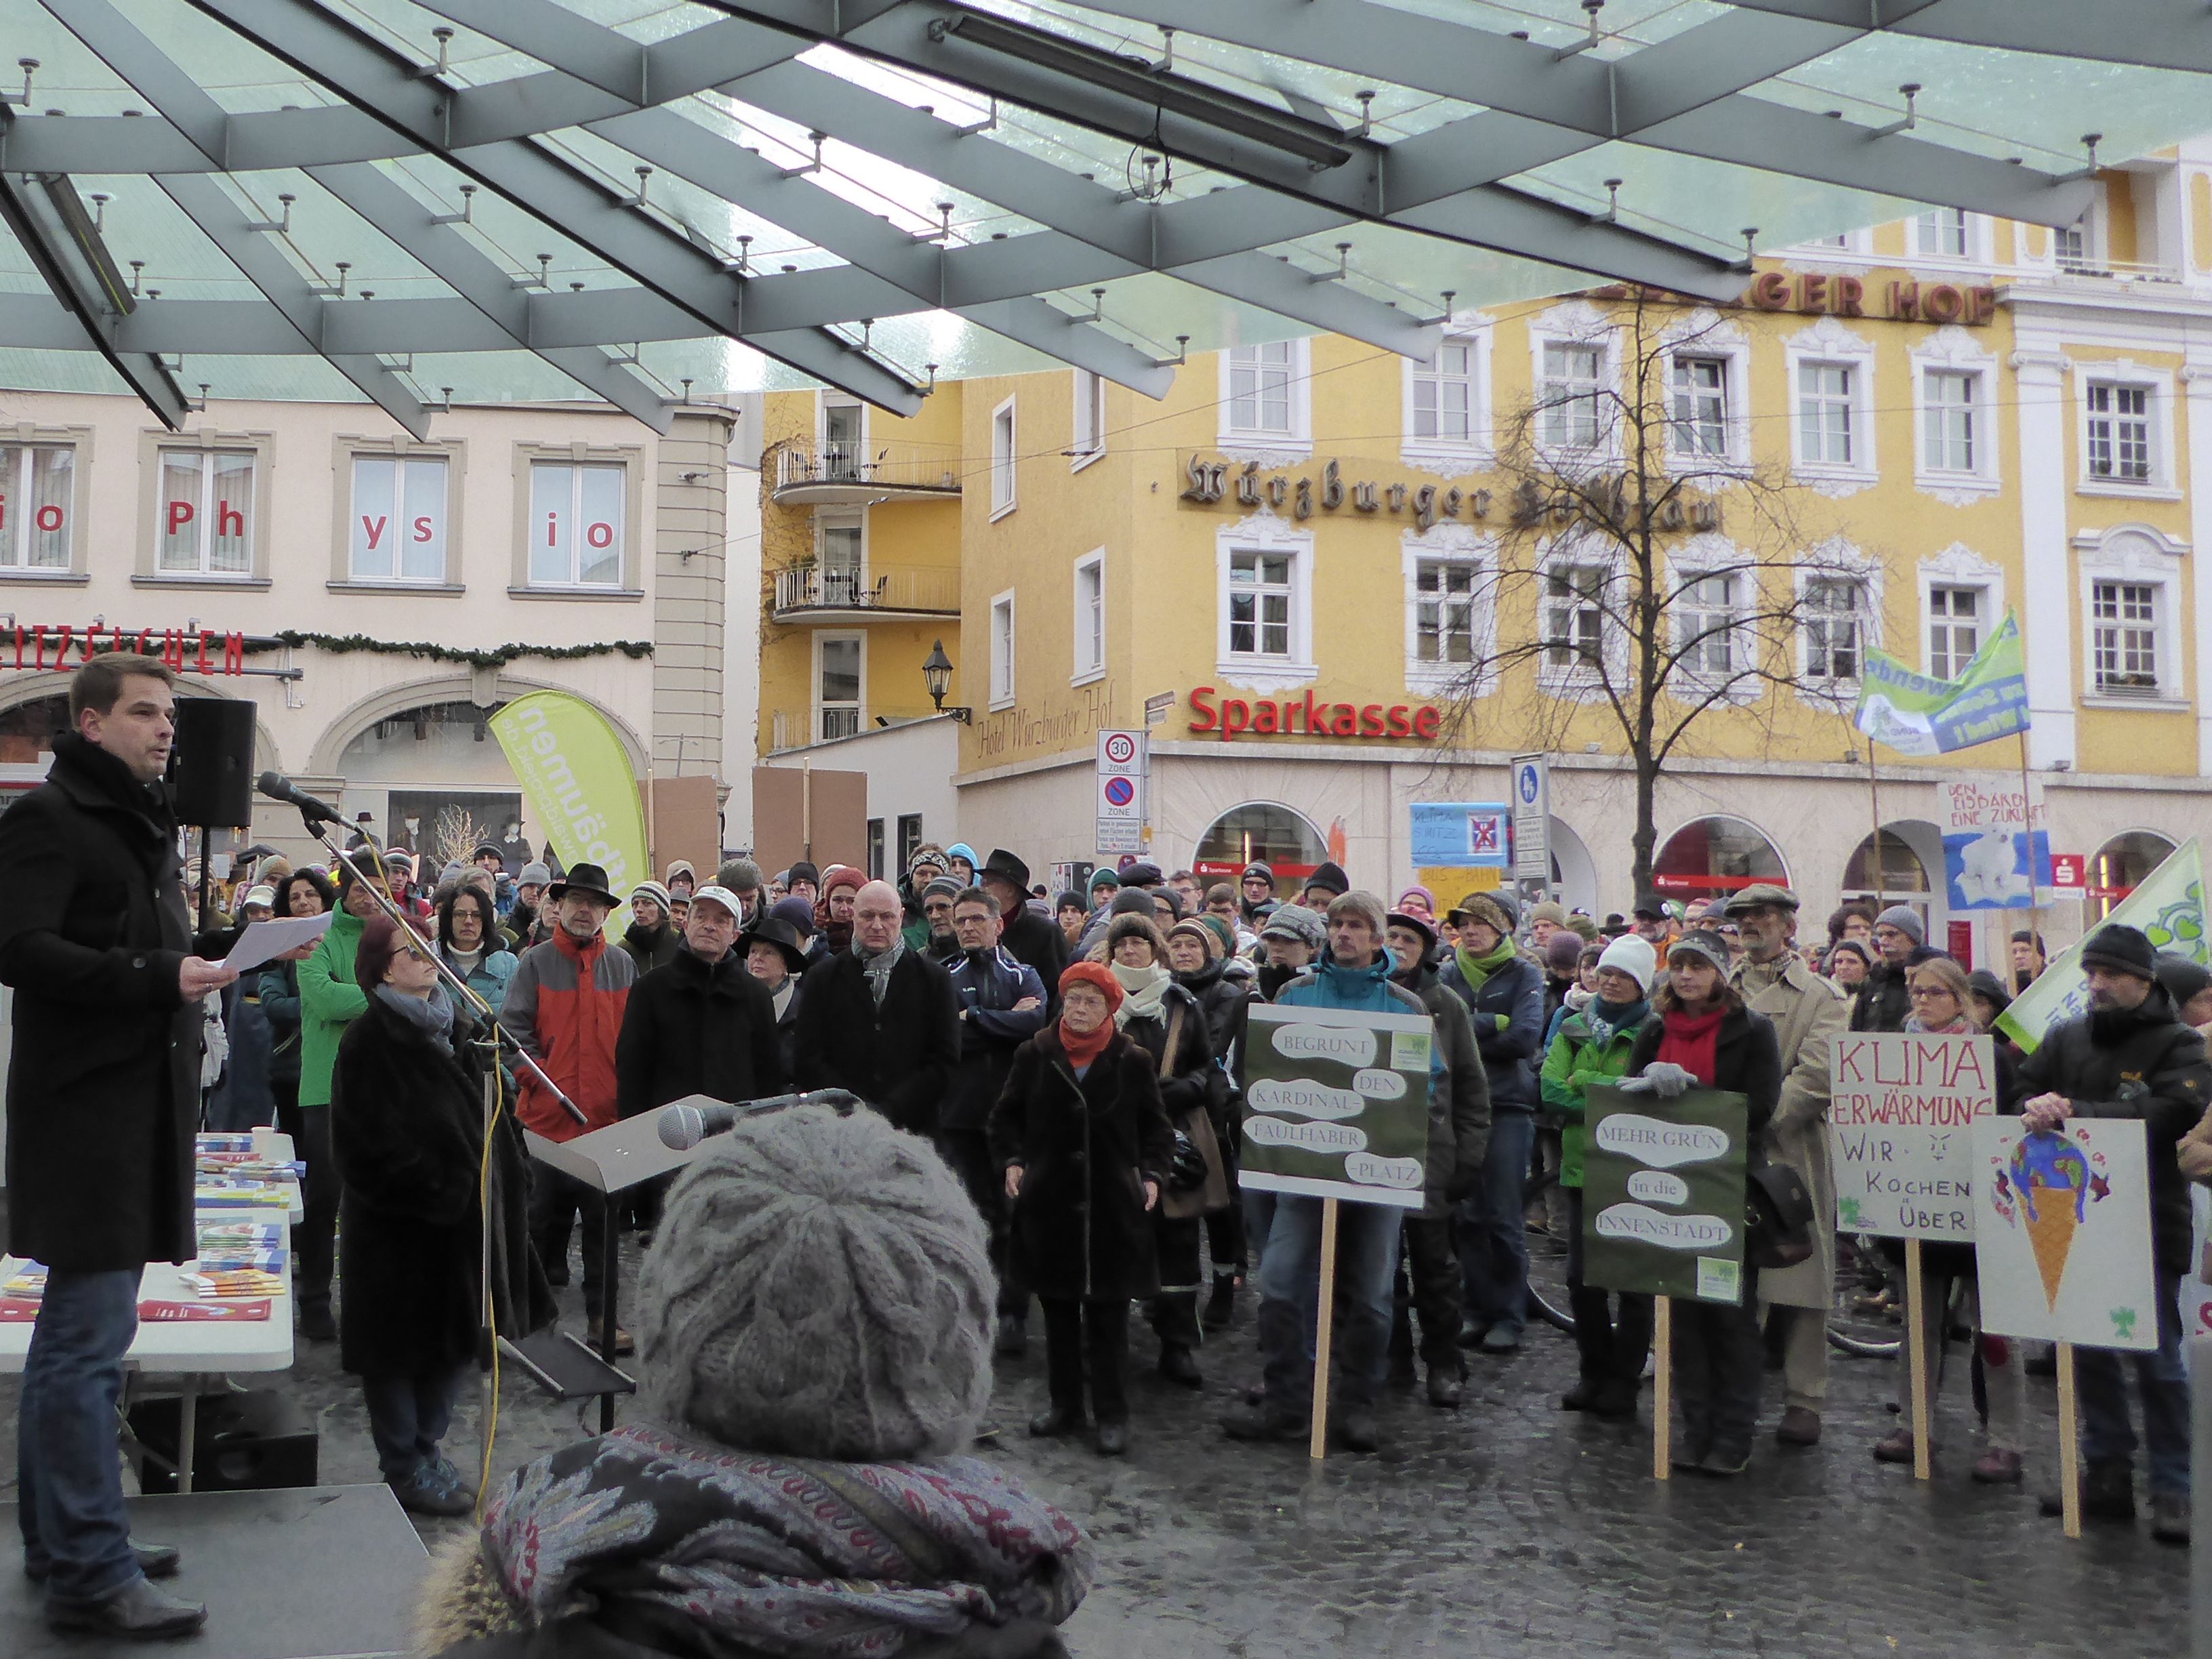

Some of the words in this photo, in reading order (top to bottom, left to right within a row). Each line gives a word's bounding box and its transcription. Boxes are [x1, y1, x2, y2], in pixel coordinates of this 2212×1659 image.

[1180, 453, 1492, 531] Würzburger
[0, 624, 243, 676] ITZEICHEN
[977, 712, 1006, 759] Hotel
[1084, 678, 1115, 735] Hof
[1189, 687, 1440, 742] Sparkasse
[1111, 741, 1129, 755] 30
[1108, 764, 1131, 773] ZONE
[1948, 783, 1977, 796] DEN
[1107, 808, 1130, 816] ZONE
[1951, 811, 1982, 827] EINE
[1838, 1040, 1986, 1090] KLIMA
[1359, 1076, 1397, 1092] DEN
[1256, 1088, 1361, 1110] KARDINAL-
[1254, 1123, 1359, 1146] FAULHABER
[1601, 1126, 1658, 1145] MEHR
[1662, 1130, 1723, 1151] GRÜN
[1840, 1132, 1893, 1162] WIR
[1351, 1162, 1418, 1181] -PLATZ
[1866, 1170, 1971, 1197] KOCHEN
[1634, 1179, 1649, 1193] in
[1654, 1180, 1677, 1195] die
[1900, 1197, 1967, 1231] ÜBER
[1597, 1214, 1727, 1242] INNENSTADT
